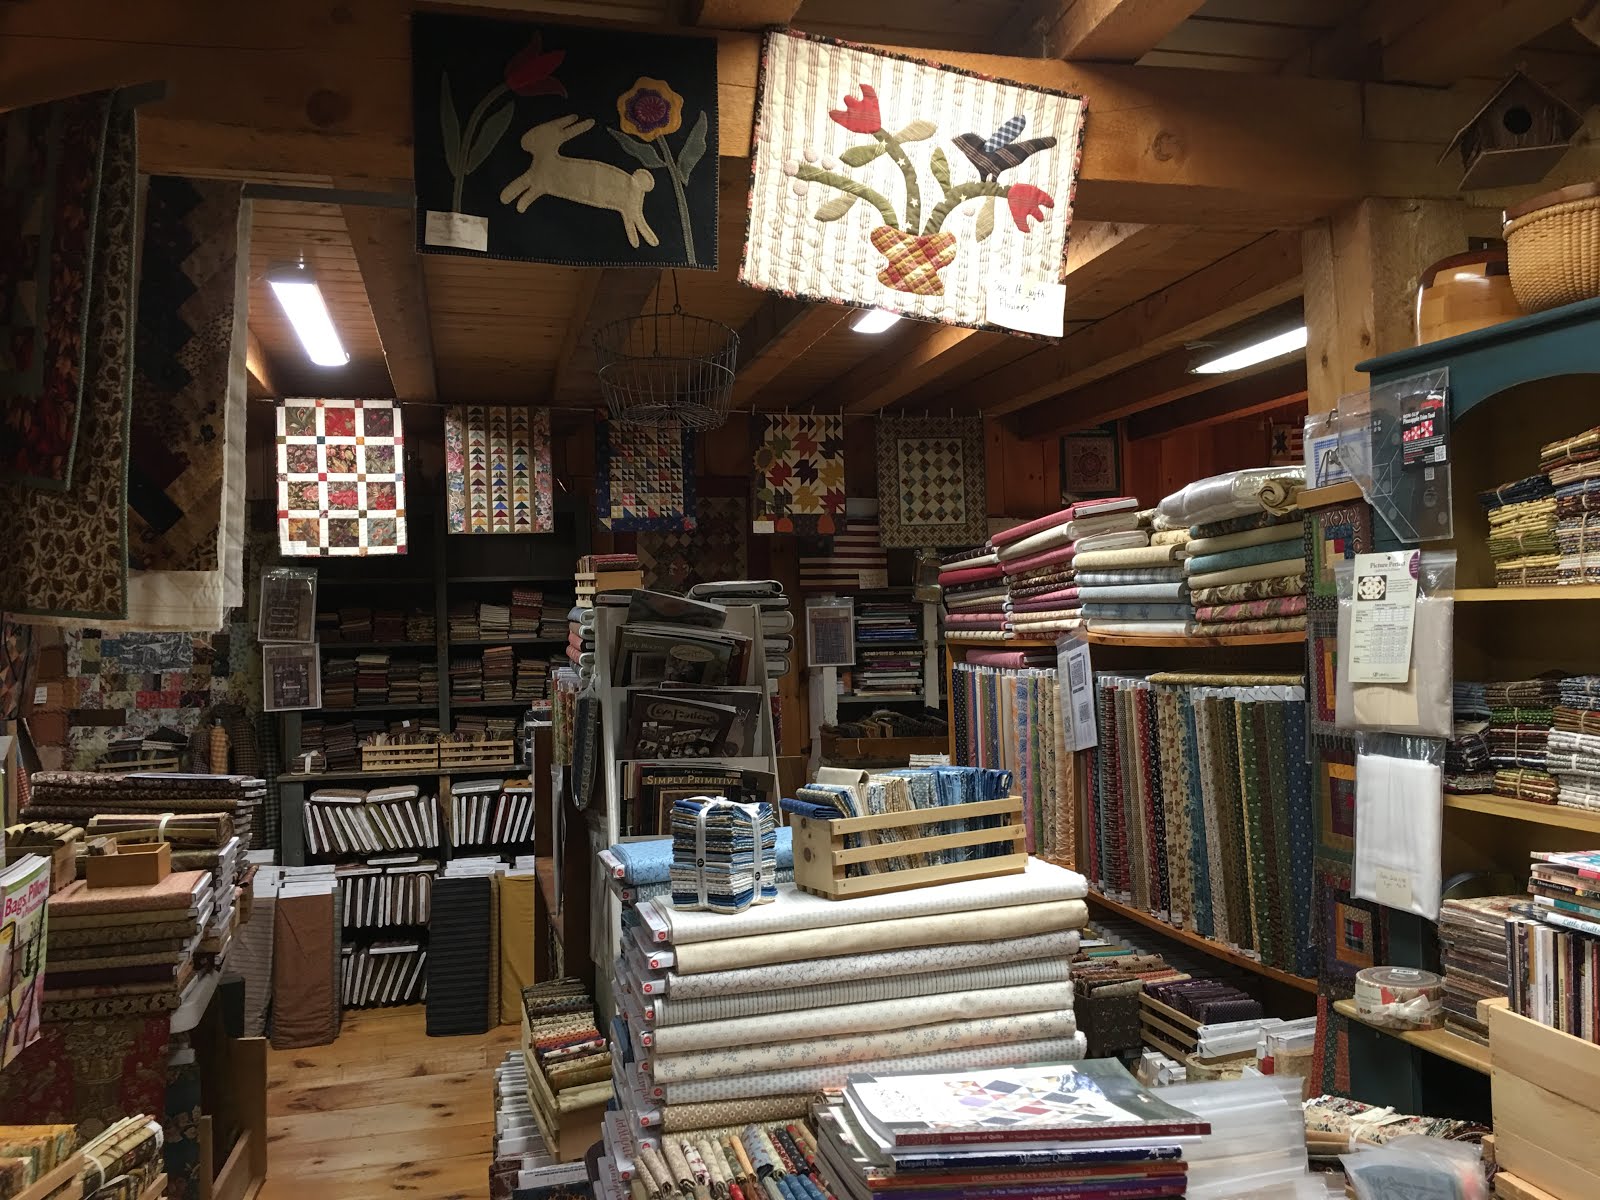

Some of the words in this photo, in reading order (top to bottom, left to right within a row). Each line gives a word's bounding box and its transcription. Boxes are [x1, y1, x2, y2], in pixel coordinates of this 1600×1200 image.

[999, 297, 1030, 313] Flowers
[646, 774, 684, 786] SIMPLY
[687, 774, 738, 786] PRIMITIVE
